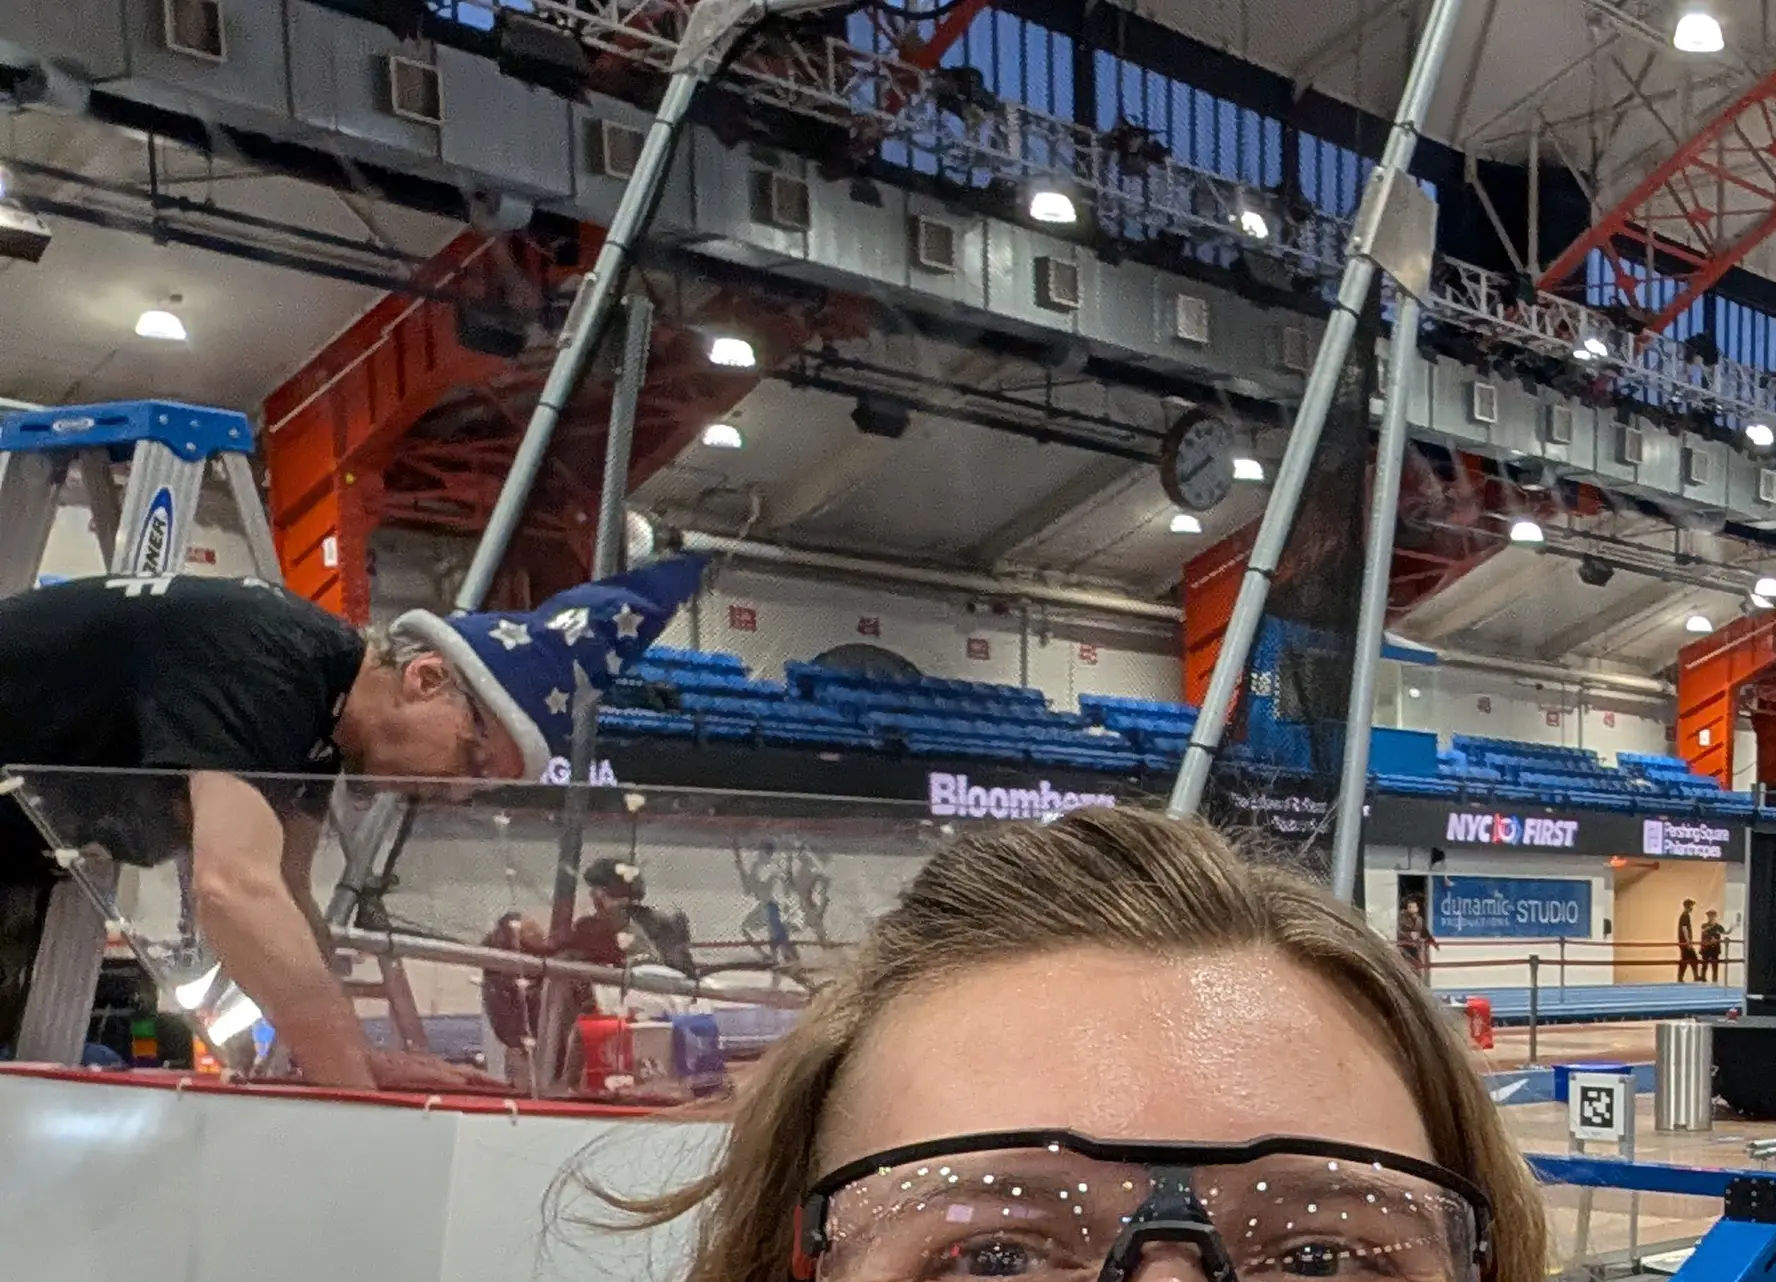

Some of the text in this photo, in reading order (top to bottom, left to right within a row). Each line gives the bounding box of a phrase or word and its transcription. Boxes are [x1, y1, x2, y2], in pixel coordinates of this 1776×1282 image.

[1446, 812, 1579, 848] NYC FIRST
[1516, 899, 1580, 924] STUDIO
